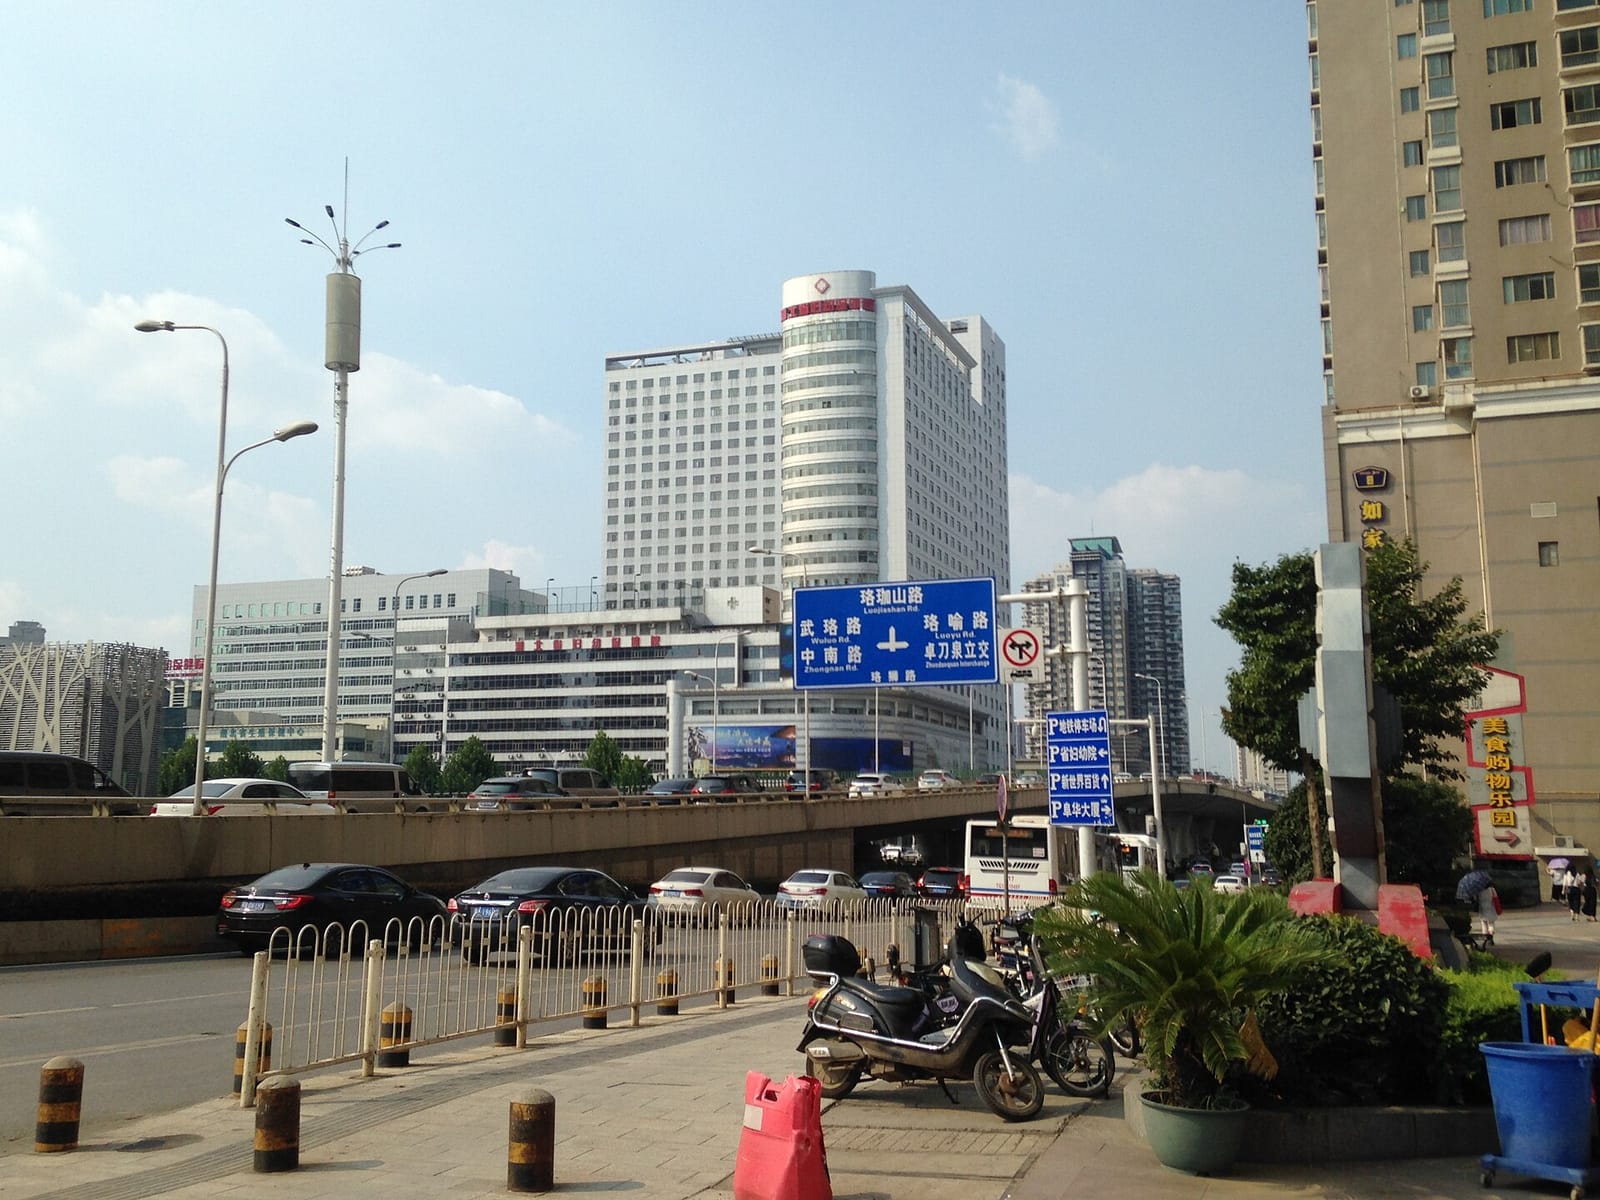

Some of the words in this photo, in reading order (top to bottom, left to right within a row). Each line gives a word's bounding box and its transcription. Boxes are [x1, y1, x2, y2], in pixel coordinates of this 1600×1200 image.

[1360, 500, 1384, 549] 如家
[860, 586, 923, 606] 珞珈山路
[800, 616, 861, 637] 武珞路
[923, 611, 988, 632] 珞喻路
[811, 637, 837, 645] Wuluo
[935, 632, 961, 640] Luoyu
[801, 645, 862, 665] 中南路
[924, 640, 989, 660] 卓刀泉立交
[804, 665, 844, 674] Zhongnan
[845, 664, 858, 672] Rd.
[1060, 717, 1097, 734] 地铁停车场
[1049, 745, 1060, 763] P
[1060, 745, 1098, 761] 省妇幼院
[1482, 717, 1517, 827] 美食购物乐园
[1050, 773, 1061, 791] P
[1061, 773, 1101, 789] 新世界百货
[1051, 801, 1062, 818] P
